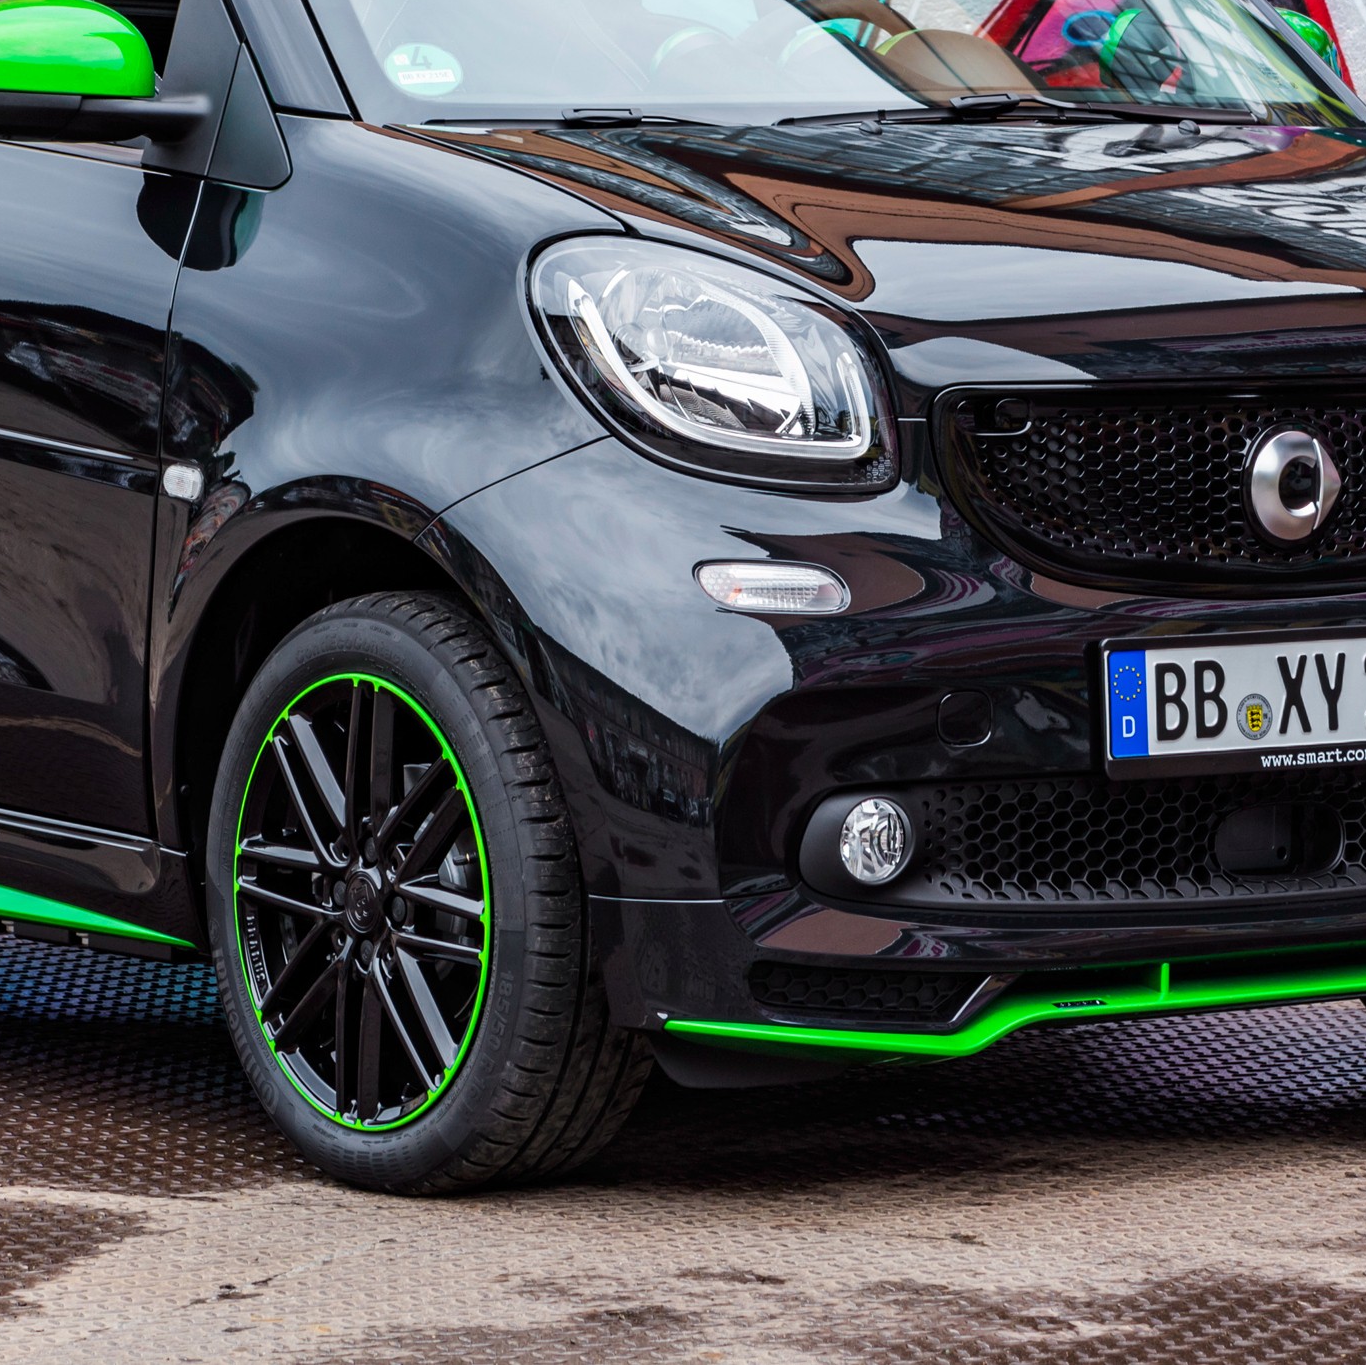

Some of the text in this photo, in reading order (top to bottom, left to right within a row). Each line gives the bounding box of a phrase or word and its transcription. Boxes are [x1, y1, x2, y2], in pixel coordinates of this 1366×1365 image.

[1155, 659, 1228, 742] BB
[1277, 652, 1346, 735] XY
[1122, 715, 1135, 738] D
